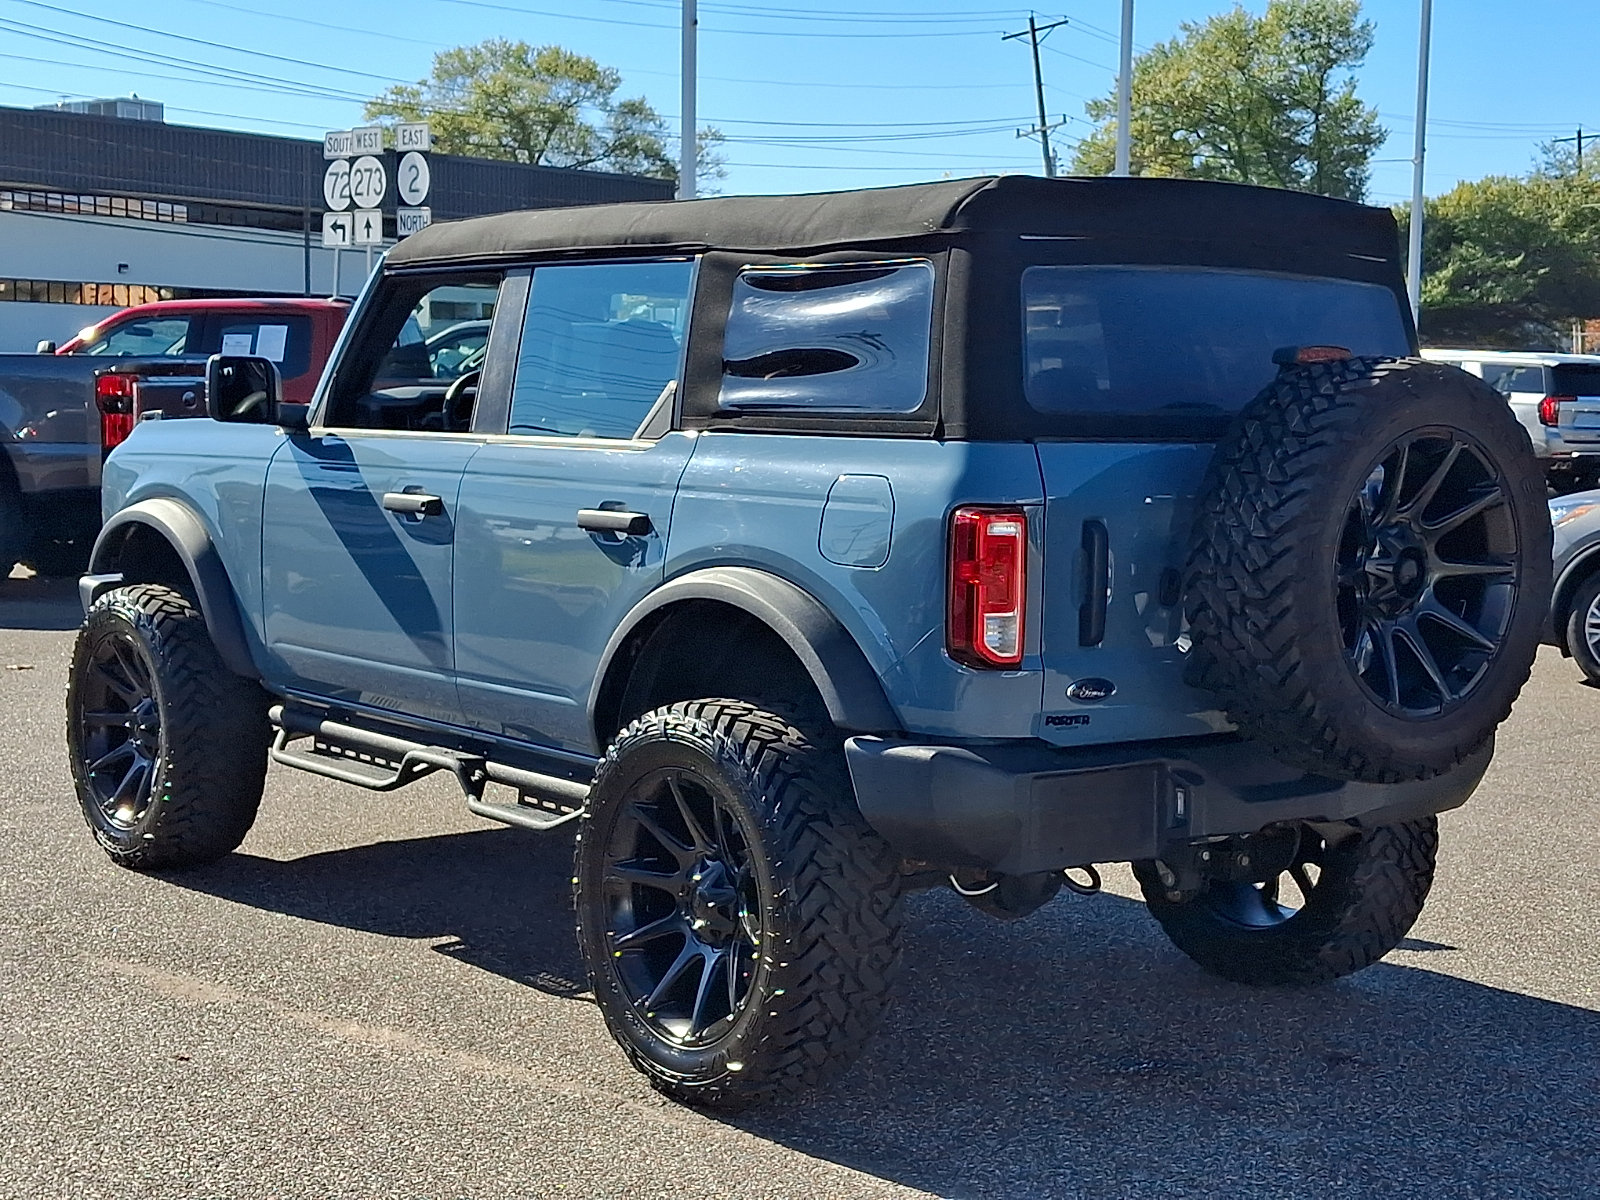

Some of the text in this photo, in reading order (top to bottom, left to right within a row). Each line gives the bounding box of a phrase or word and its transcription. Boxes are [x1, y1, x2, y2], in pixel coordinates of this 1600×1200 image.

[355, 132, 378, 149] WEST
[402, 129, 424, 146] EAST
[328, 171, 351, 199] 72
[354, 167, 383, 197] 273
[408, 164, 420, 193] 2
[400, 214, 428, 232] NORTH
[1045, 714, 1090, 726] PORTER
